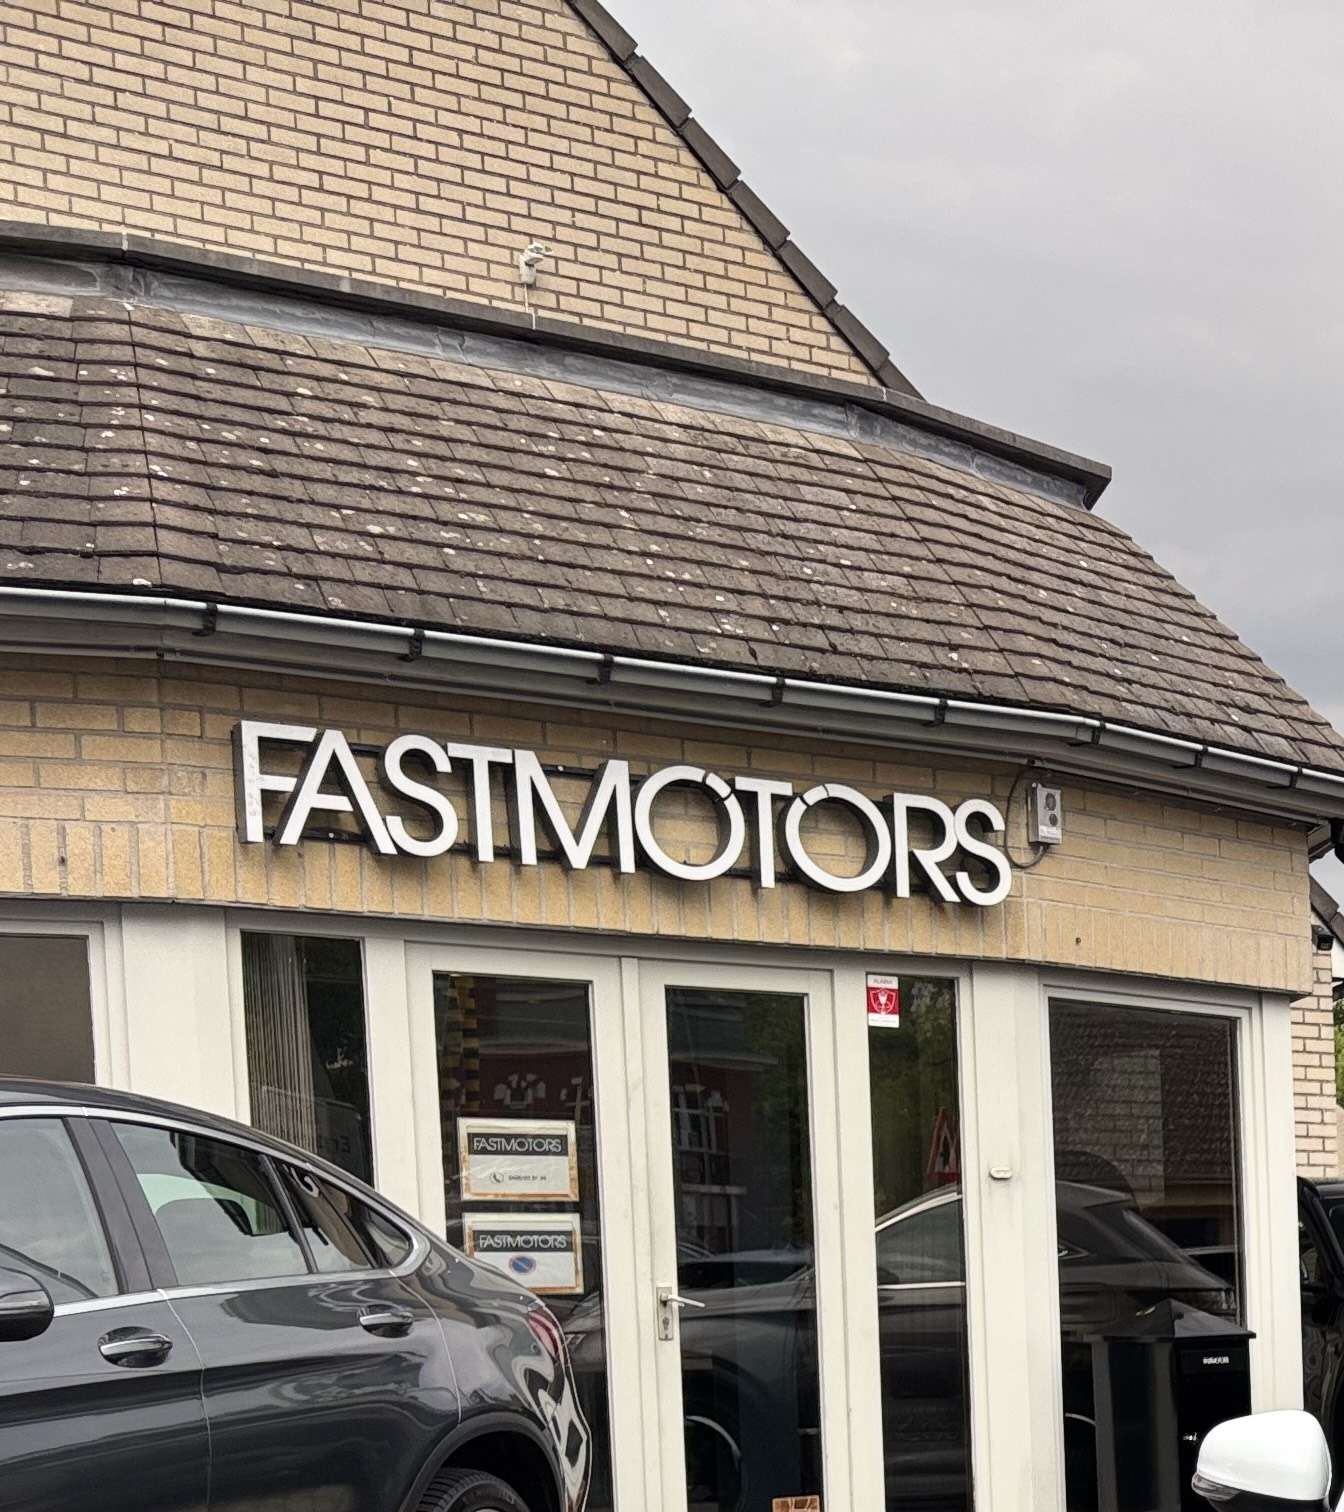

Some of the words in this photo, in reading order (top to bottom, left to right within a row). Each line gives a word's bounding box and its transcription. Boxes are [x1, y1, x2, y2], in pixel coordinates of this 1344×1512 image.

[234, 720, 1014, 907] FASTMOTORS
[473, 1137, 562, 1152] FASTMOTORS
[479, 1234, 567, 1249] FASTMOTORS
